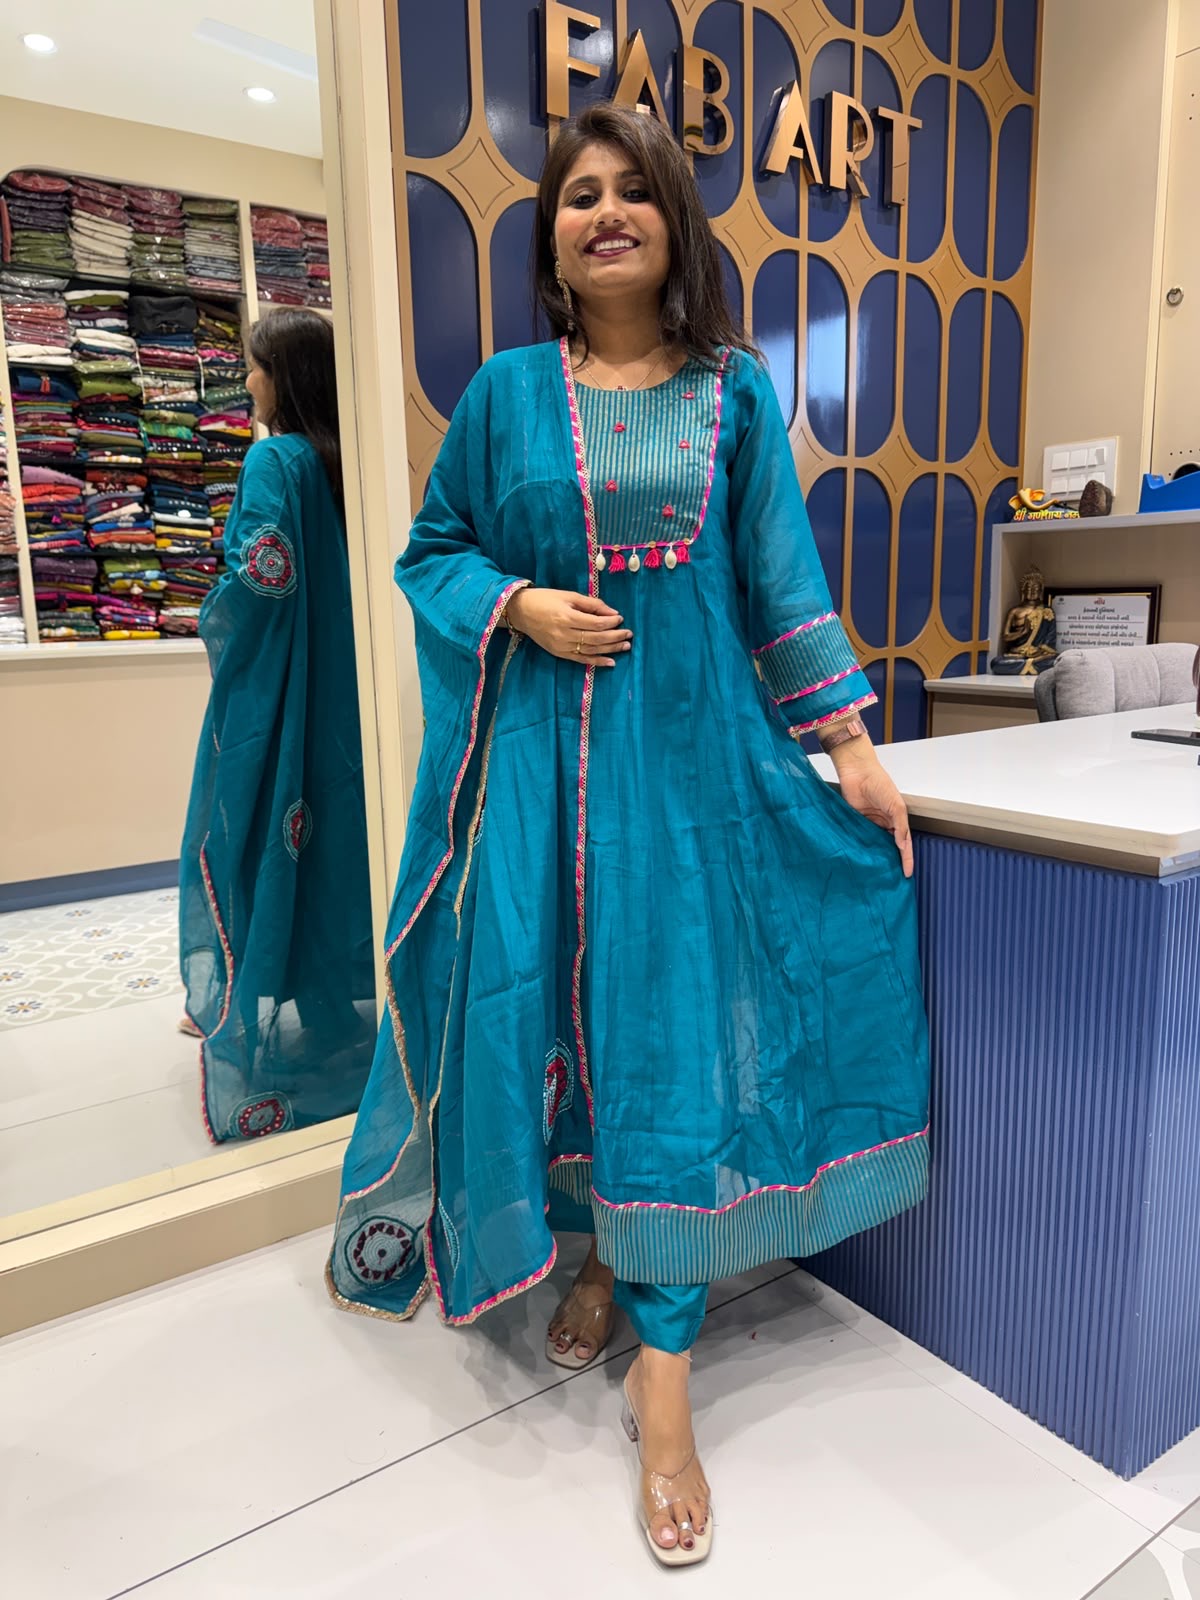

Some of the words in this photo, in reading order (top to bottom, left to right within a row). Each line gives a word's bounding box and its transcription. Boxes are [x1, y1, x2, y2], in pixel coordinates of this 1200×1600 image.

[541, 0, 735, 155] FAB
[758, 79, 923, 208] ART
[1014, 507, 1027, 521] श्री
